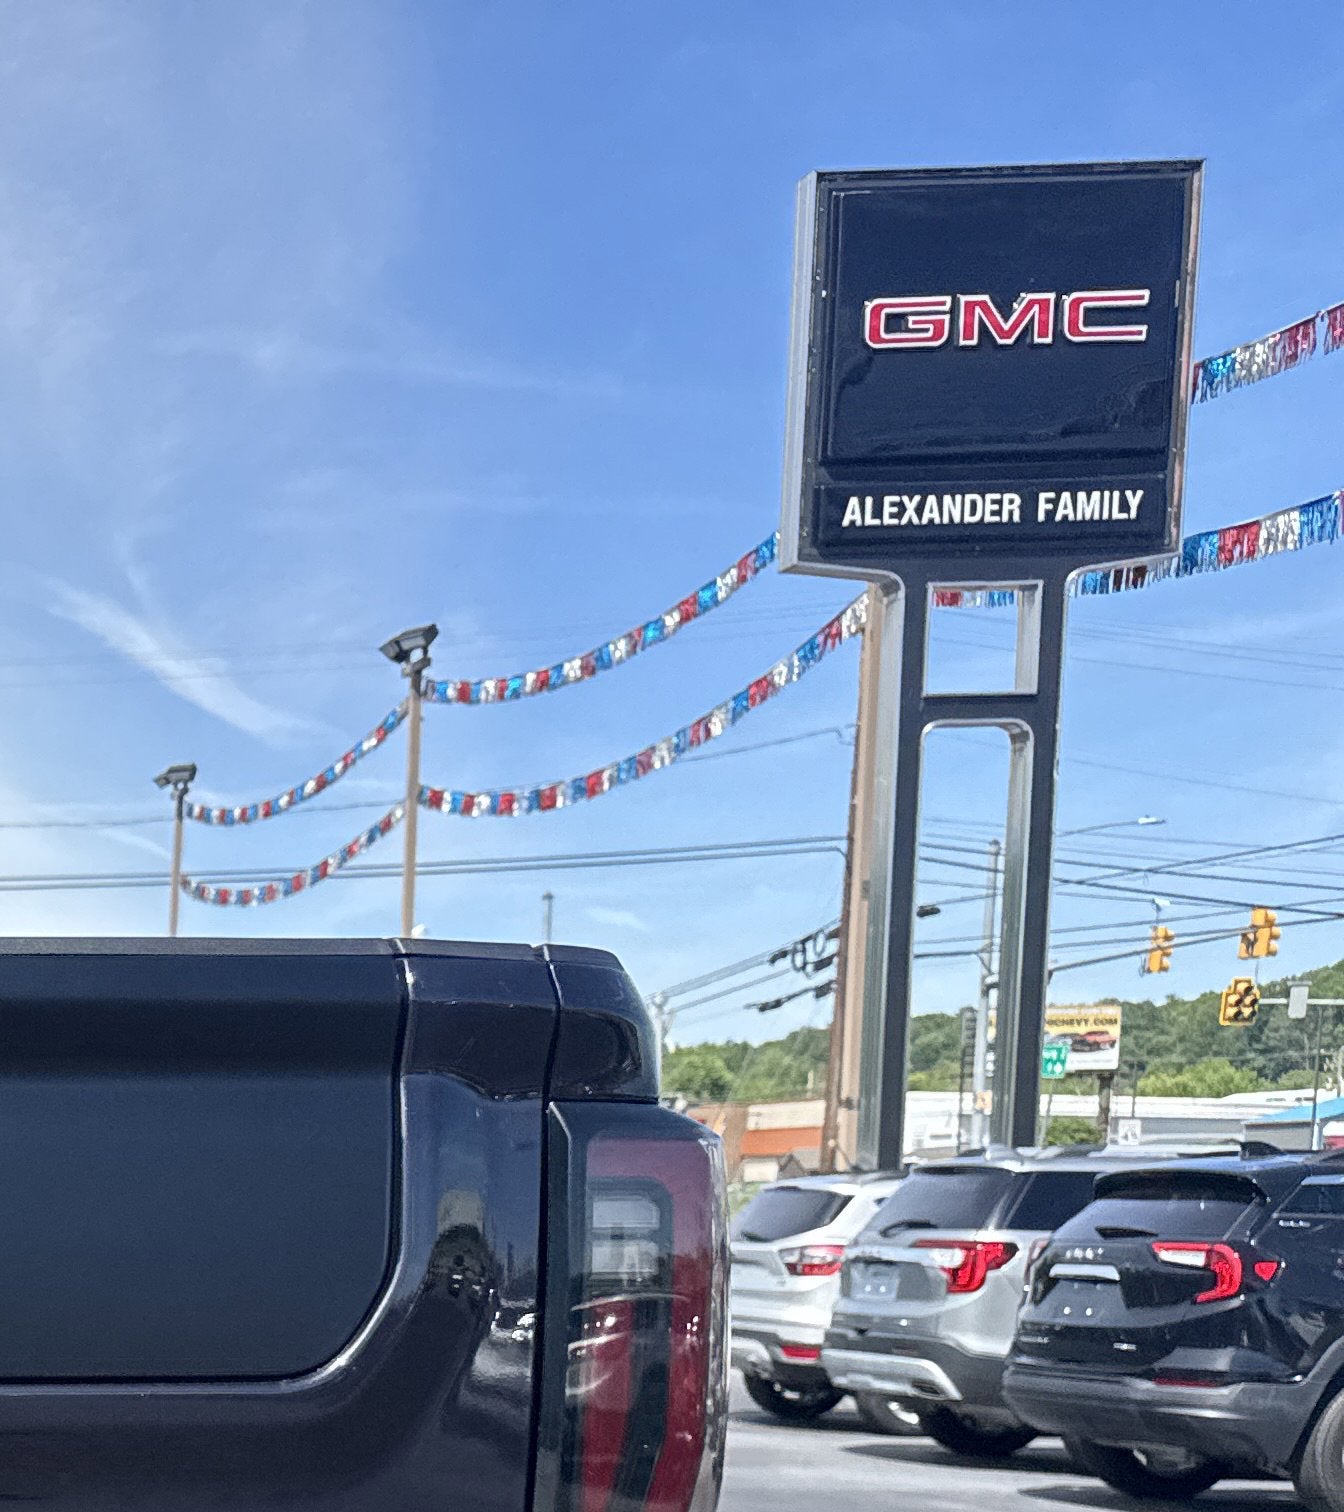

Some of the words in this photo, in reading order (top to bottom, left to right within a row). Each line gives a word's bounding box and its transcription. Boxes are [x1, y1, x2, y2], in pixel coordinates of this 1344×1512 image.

[864, 289, 1151, 349] GMC
[841, 494, 1021, 528] ALEXANDER
[1037, 489, 1145, 525] FAMILY
